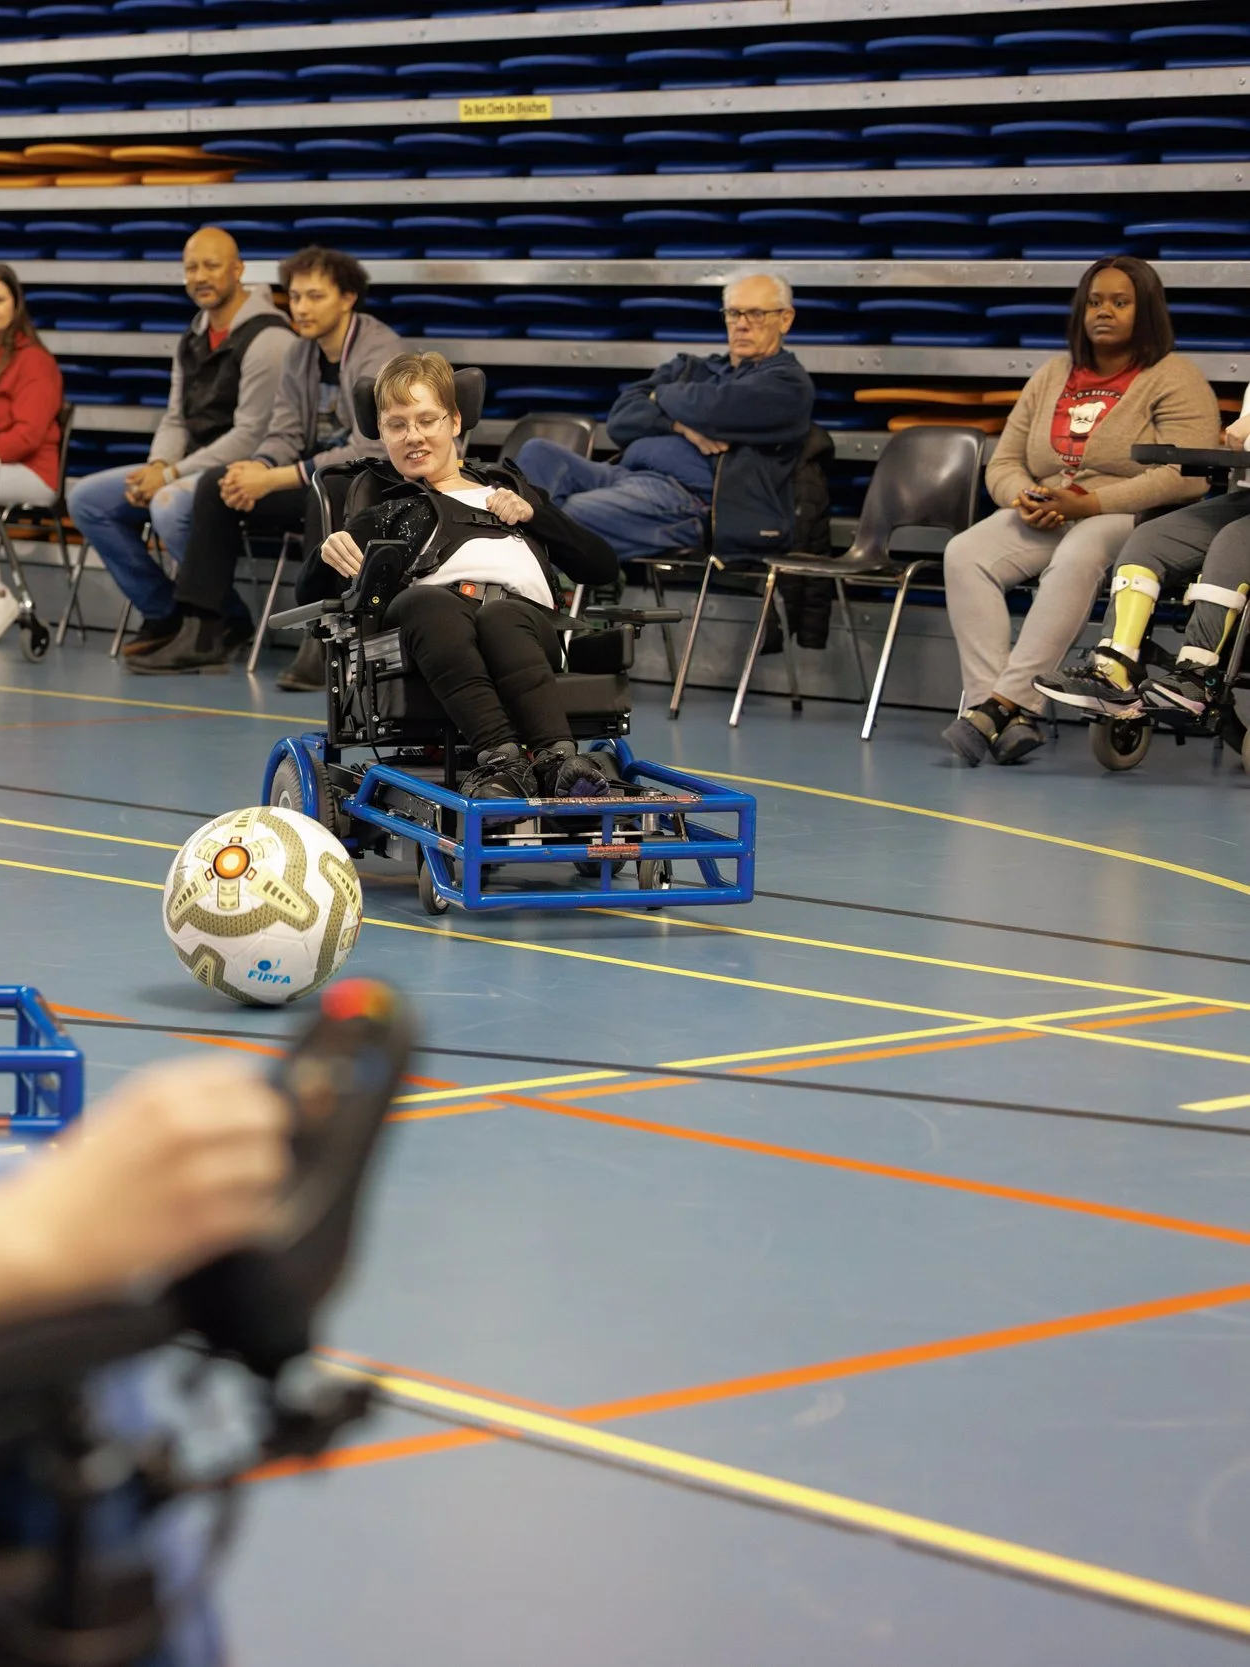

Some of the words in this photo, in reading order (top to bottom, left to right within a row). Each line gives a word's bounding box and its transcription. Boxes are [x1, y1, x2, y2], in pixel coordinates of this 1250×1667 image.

[463, 104, 472, 116] Do
[474, 104, 485, 115] Not
[487, 103, 505, 114] Climb
[507, 102, 516, 114] On
[517, 101, 547, 114] Bleachers
[247, 970, 291, 984] FIPFA
